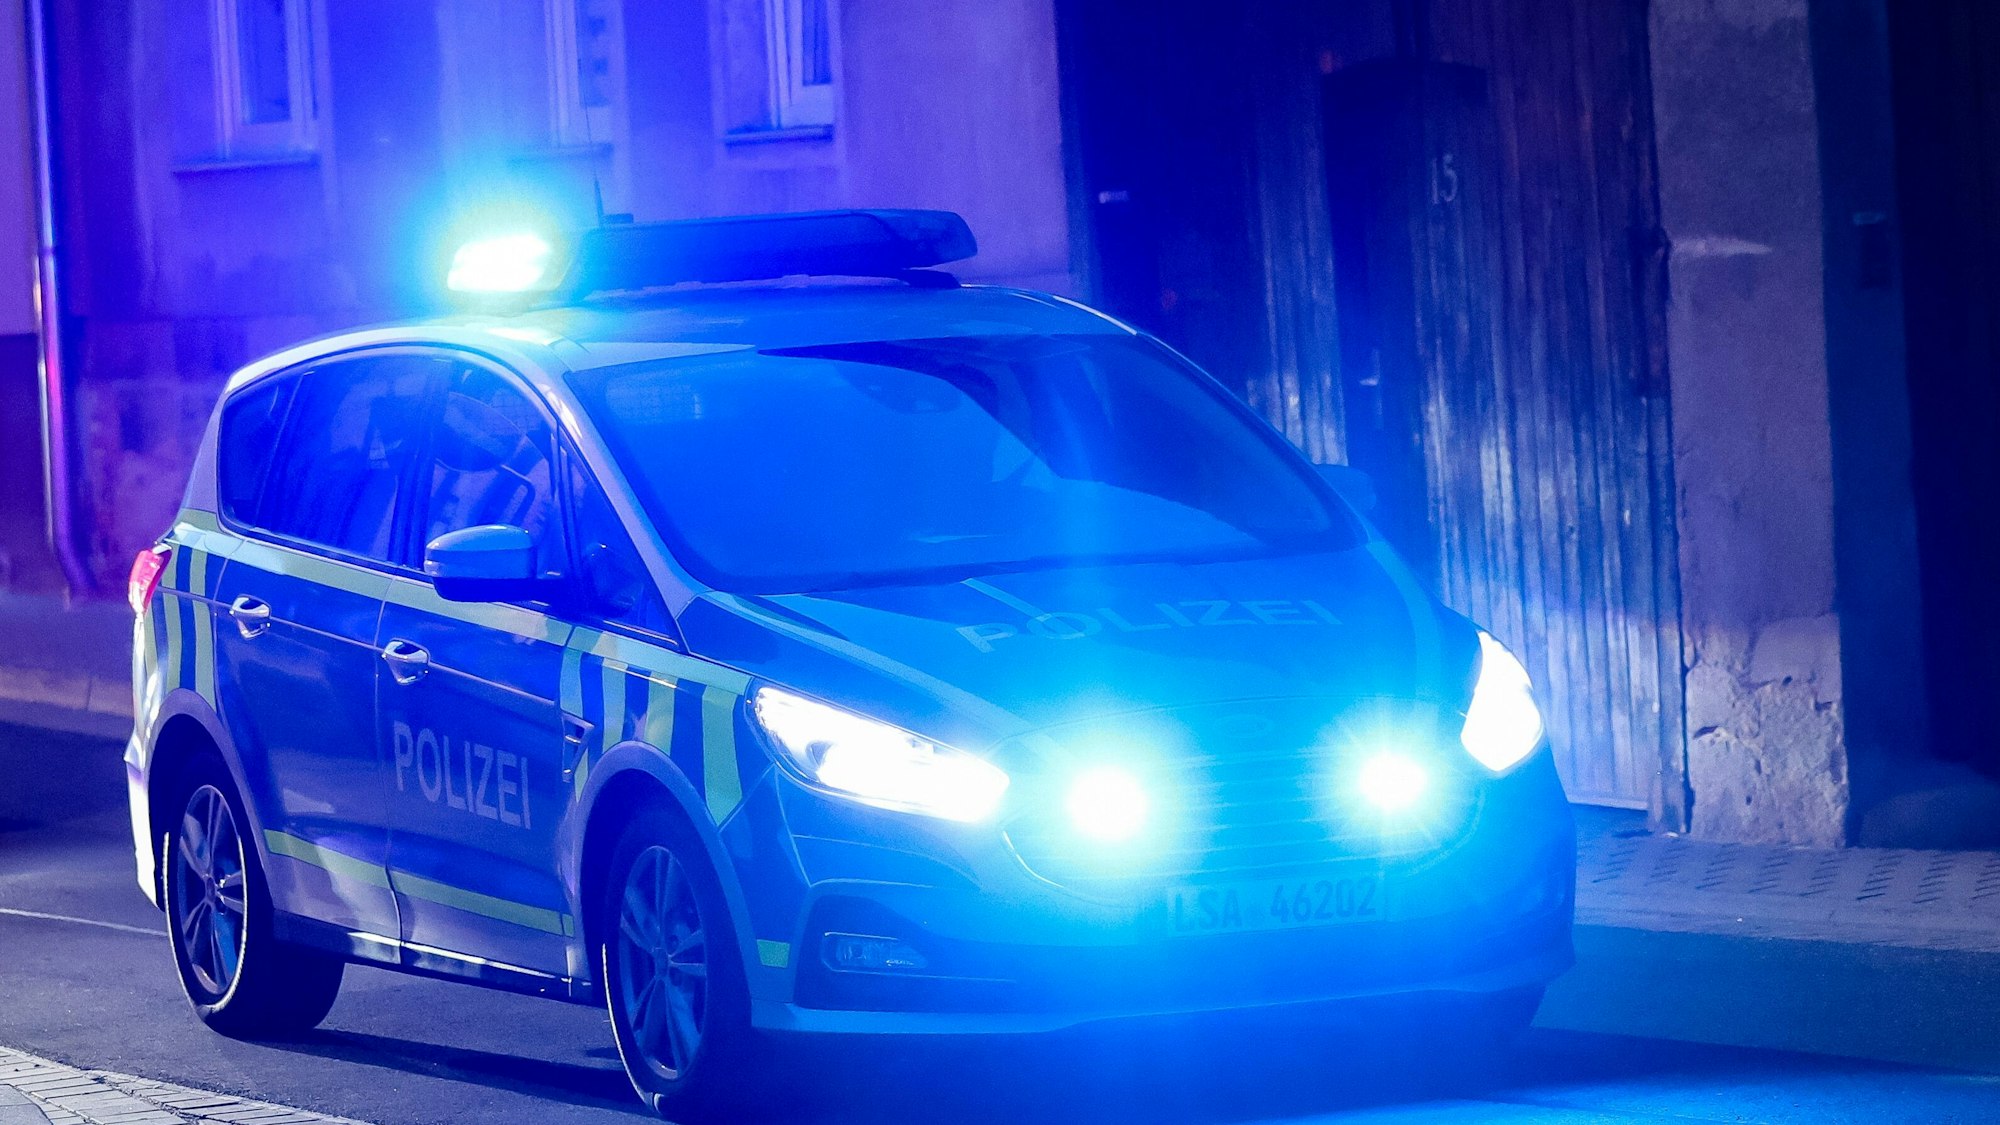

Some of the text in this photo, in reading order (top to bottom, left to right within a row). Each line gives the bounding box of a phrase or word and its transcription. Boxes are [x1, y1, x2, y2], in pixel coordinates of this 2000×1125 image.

[1431, 153, 1458, 205] 15
[956, 600, 1343, 654] POLIZEI
[394, 720, 531, 829] POLIZEI
[1175, 877, 1377, 932] LSA 46202
